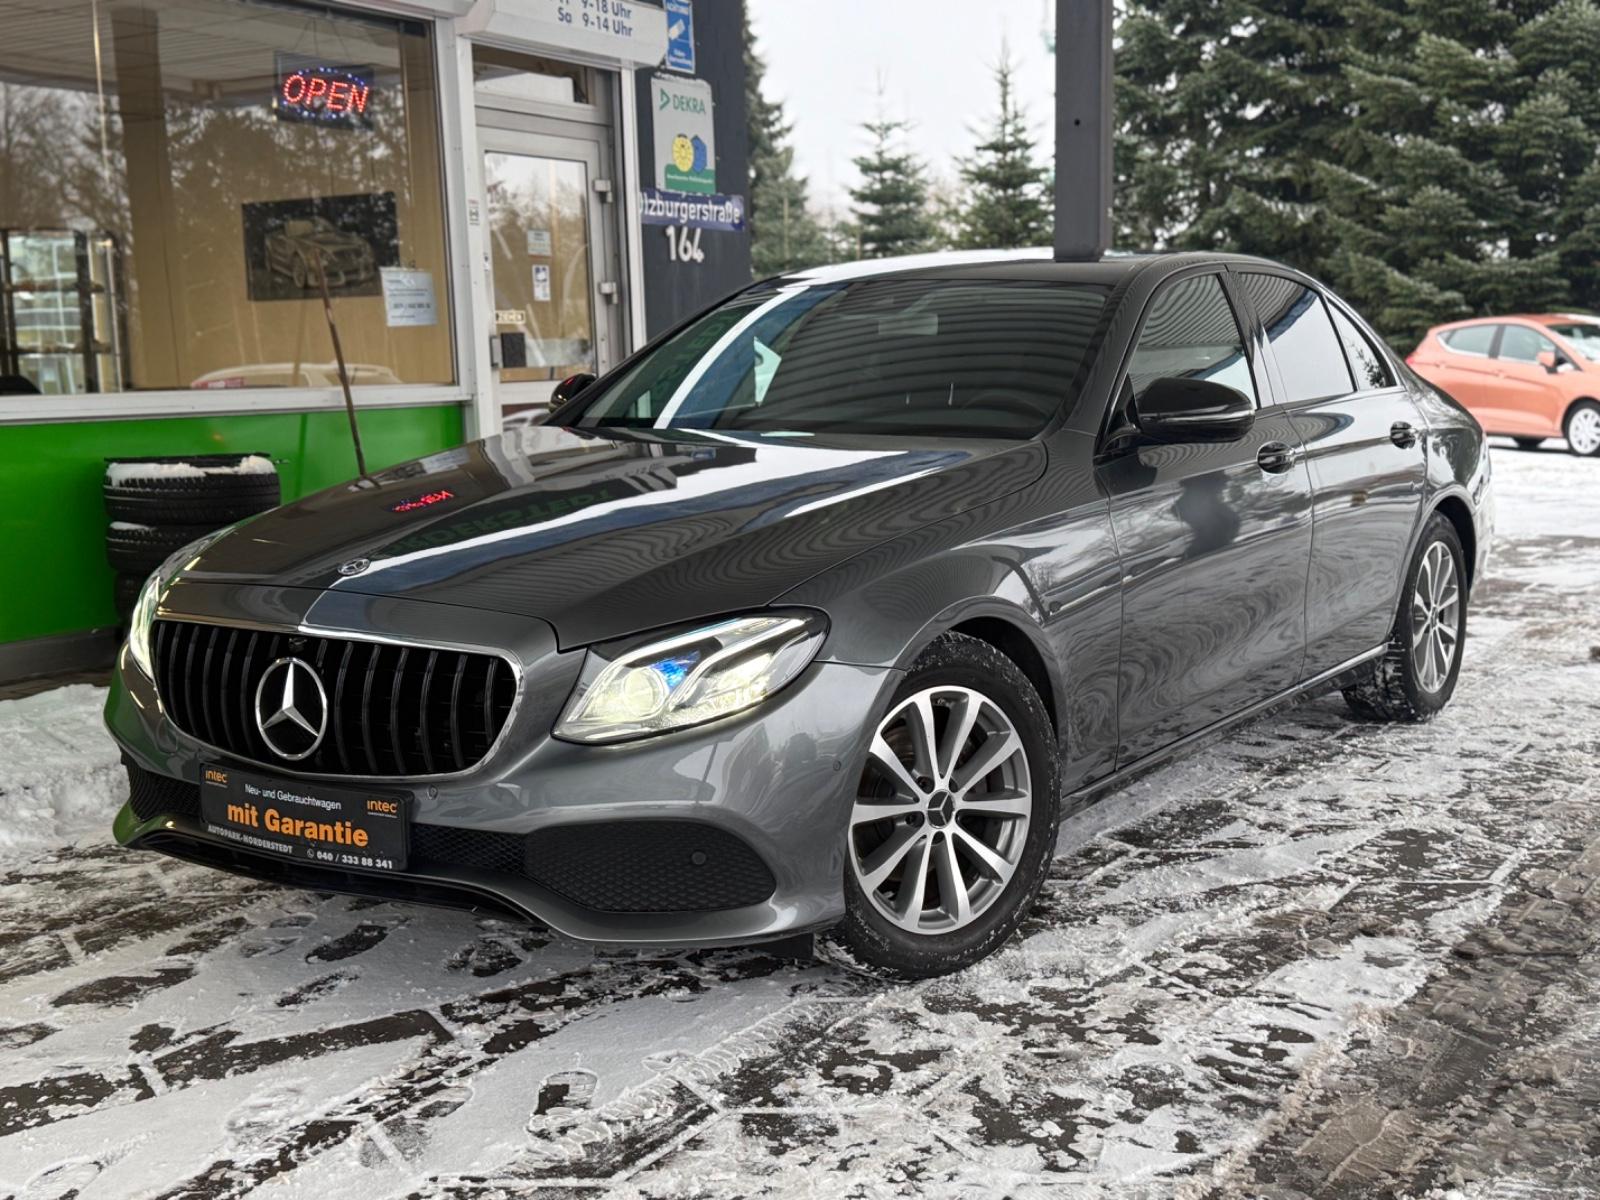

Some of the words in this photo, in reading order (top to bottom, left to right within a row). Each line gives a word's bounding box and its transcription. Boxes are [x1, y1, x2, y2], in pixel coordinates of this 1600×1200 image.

[558, 7, 572, 23] Sa
[582, 13, 609, 31] 9-14
[612, 19, 633, 36] Uhr
[611, 1, 632, 18] Uhr
[283, 74, 369, 113] OPEN
[673, 94, 706, 115] DEKRA
[665, 224, 705, 263] 164
[205, 770, 227, 783] intec
[245, 784, 261, 796] Neu-
[262, 789, 276, 799] und
[276, 790, 342, 811] Gebrauchtwagen
[366, 800, 398, 813] intec
[227, 802, 259, 828] mit
[264, 808, 369, 848] Garantie
[316, 851, 333, 861] 040
[341, 854, 359, 865] 333
[361, 857, 373, 867] 88
[375, 858, 392, 869] 341
